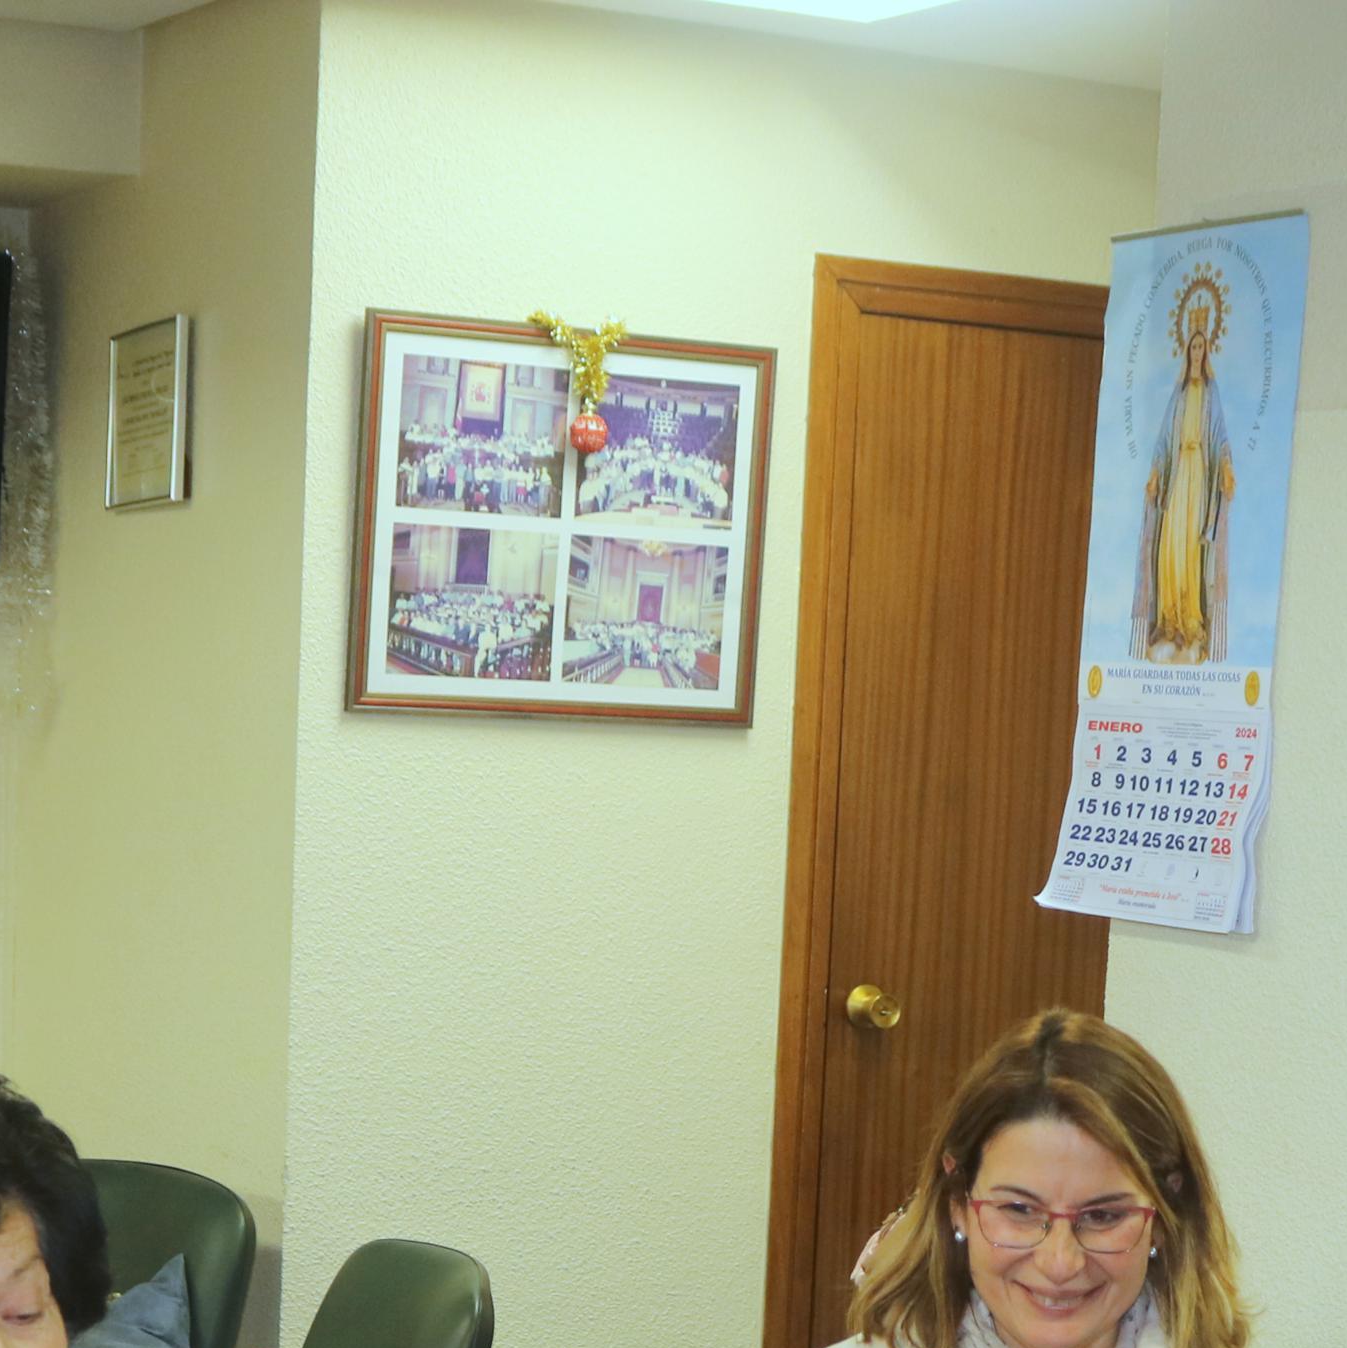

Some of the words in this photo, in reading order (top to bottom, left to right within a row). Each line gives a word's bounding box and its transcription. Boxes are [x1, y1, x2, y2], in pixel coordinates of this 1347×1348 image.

[1107, 667, 1131, 680] MARÍA
[1132, 668, 1173, 681] GUARDABA
[1175, 669, 1201, 681] TODAS
[1202, 671, 1215, 682] LAS
[1217, 672, 1241, 683] COSAS
[1142, 684, 1152, 694] EN
[1153, 685, 1164, 695] SU
[1165, 684, 1201, 697] CORAZÓN
[1088, 720, 1143, 733] ENERO
[1235, 727, 1257, 739] 2024
[1094, 743, 1102, 760] 1
[1117, 745, 1127, 762] 2
[1141, 747, 1152, 763] 3
[1167, 749, 1177, 765] 4
[1192, 751, 1202, 767] 5
[1217, 753, 1228, 769] 6
[1244, 755, 1254, 771] 7
[1091, 772, 1101, 787] 8
[1115, 773, 1125, 789] 9
[1130, 775, 1149, 792] 10
[1154, 778, 1173, 794] 11
[1179, 779, 1199, 796] 12
[1204, 781, 1224, 798] 13
[1228, 783, 1248, 800] 14
[1077, 798, 1097, 814] 15
[1102, 800, 1121, 816] 16
[1126, 802, 1146, 819] 17
[1150, 804, 1169, 821] 18
[1174, 807, 1193, 823] 19
[1195, 809, 1216, 825] 20
[1216, 811, 1238, 827] 21
[1070, 824, 1092, 840] 22
[1094, 827, 1116, 843] 23
[1118, 829, 1138, 846] 24
[1142, 831, 1162, 848] 25
[1165, 834, 1185, 850] 26
[1188, 836, 1208, 852] 27
[1211, 838, 1231, 855] 28
[1063, 851, 1085, 867] 29
[1086, 853, 1109, 870] 30
[1110, 856, 1133, 872] 31
